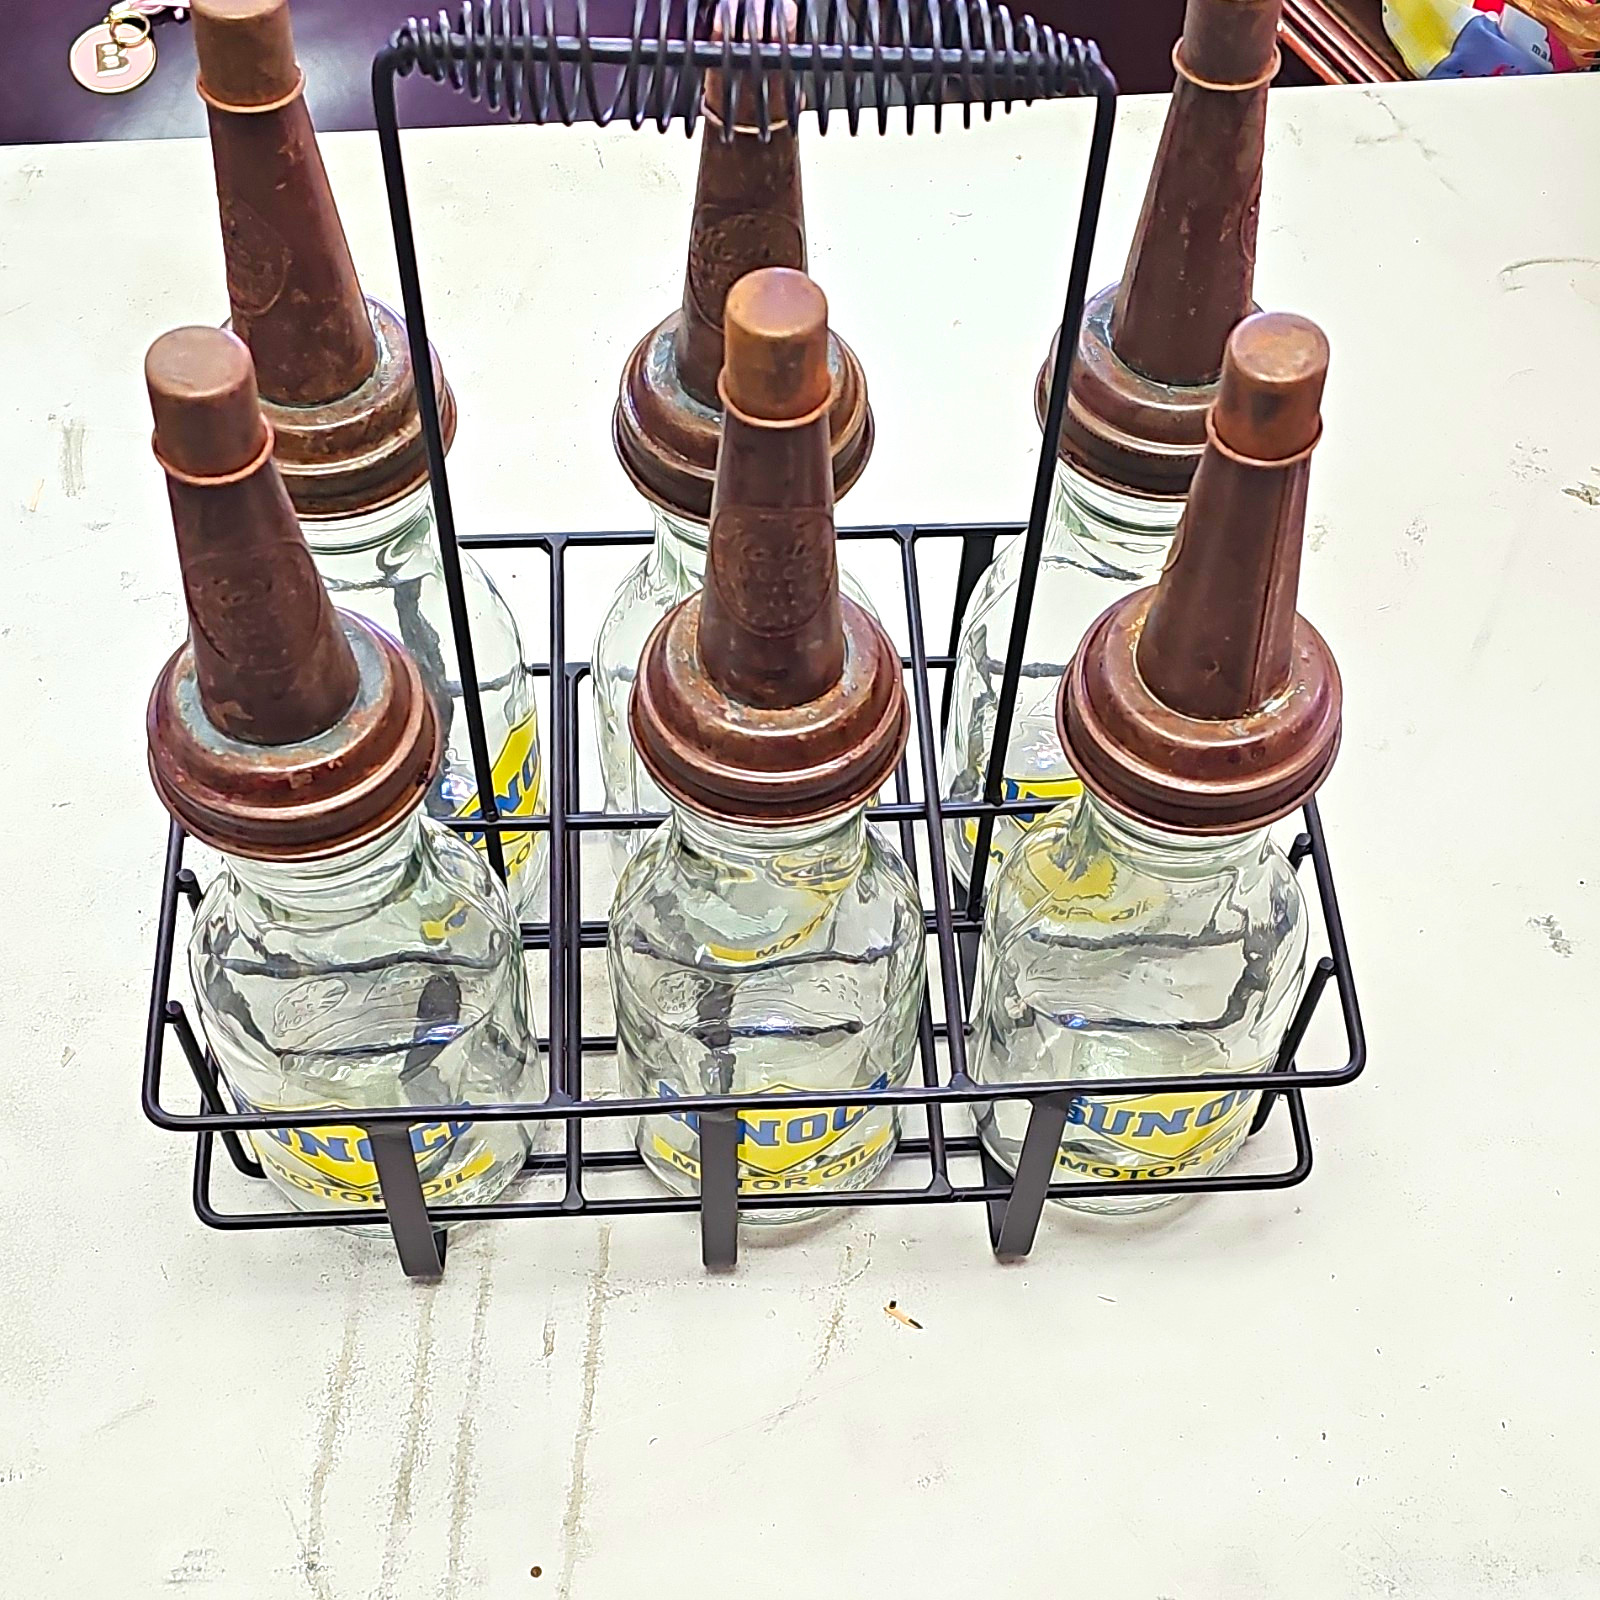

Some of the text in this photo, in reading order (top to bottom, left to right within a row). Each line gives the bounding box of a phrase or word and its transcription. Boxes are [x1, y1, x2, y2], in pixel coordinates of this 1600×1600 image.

[95, 42, 130, 75] B
[1065, 1089, 1254, 1136] SUNO
[672, 1147, 876, 1189] MOR OIL
[1059, 1155, 1202, 1179] MOTOR
